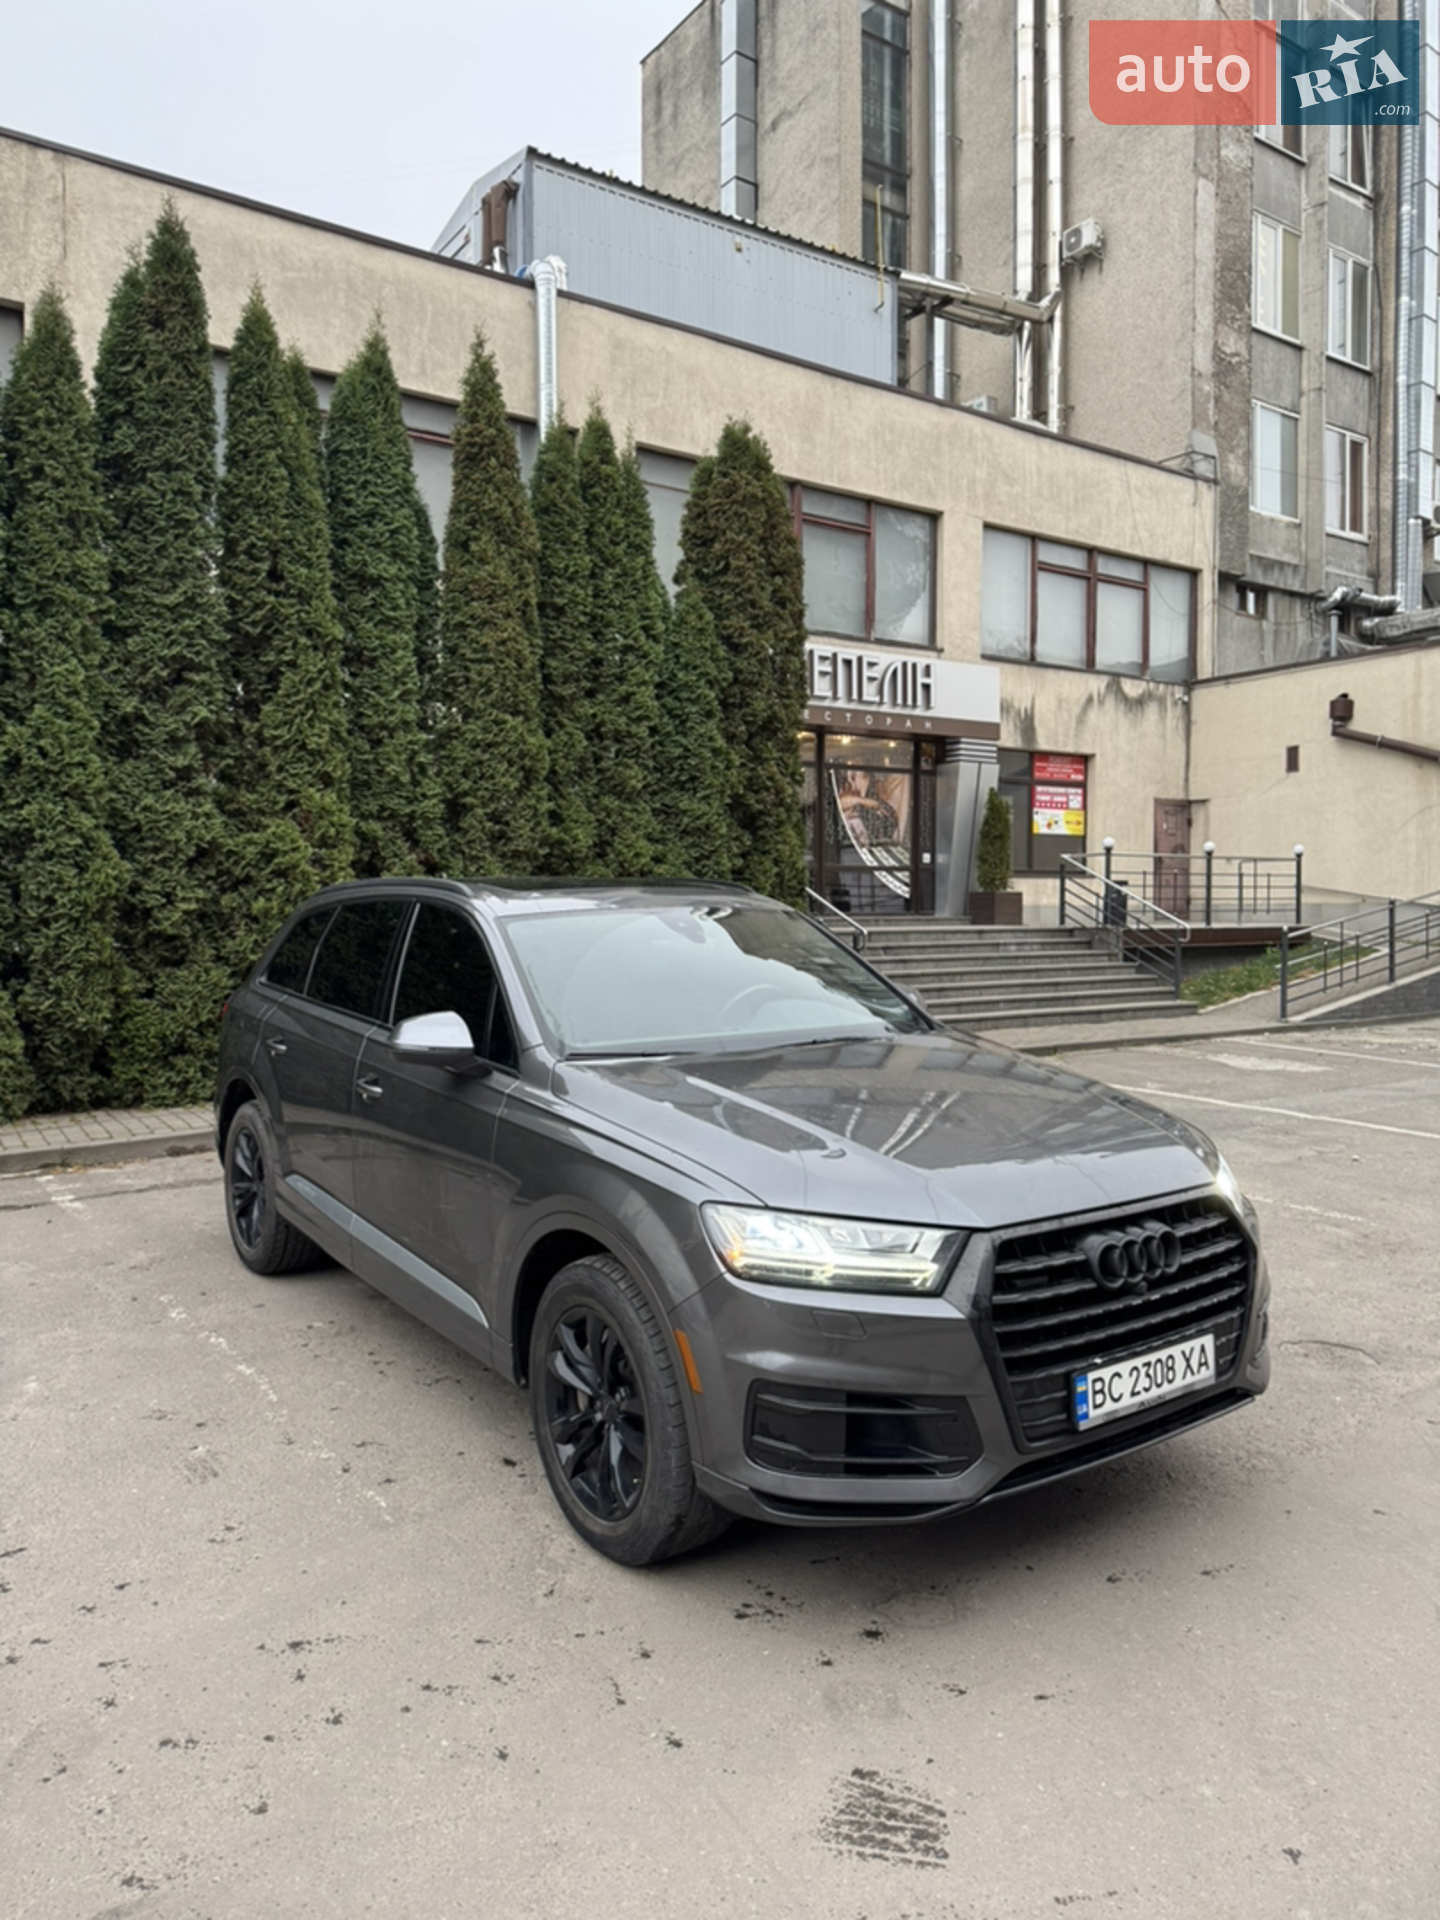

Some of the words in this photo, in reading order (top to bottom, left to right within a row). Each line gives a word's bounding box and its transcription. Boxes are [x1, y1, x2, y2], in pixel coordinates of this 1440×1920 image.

[809, 648, 935, 710] ЕПЕЛІН
[804, 709, 933, 730] ЕСТОРАН
[1091, 1370, 1124, 1410] BC
[1129, 1353, 1176, 1398] 2308
[1181, 1342, 1211, 1380] XA
